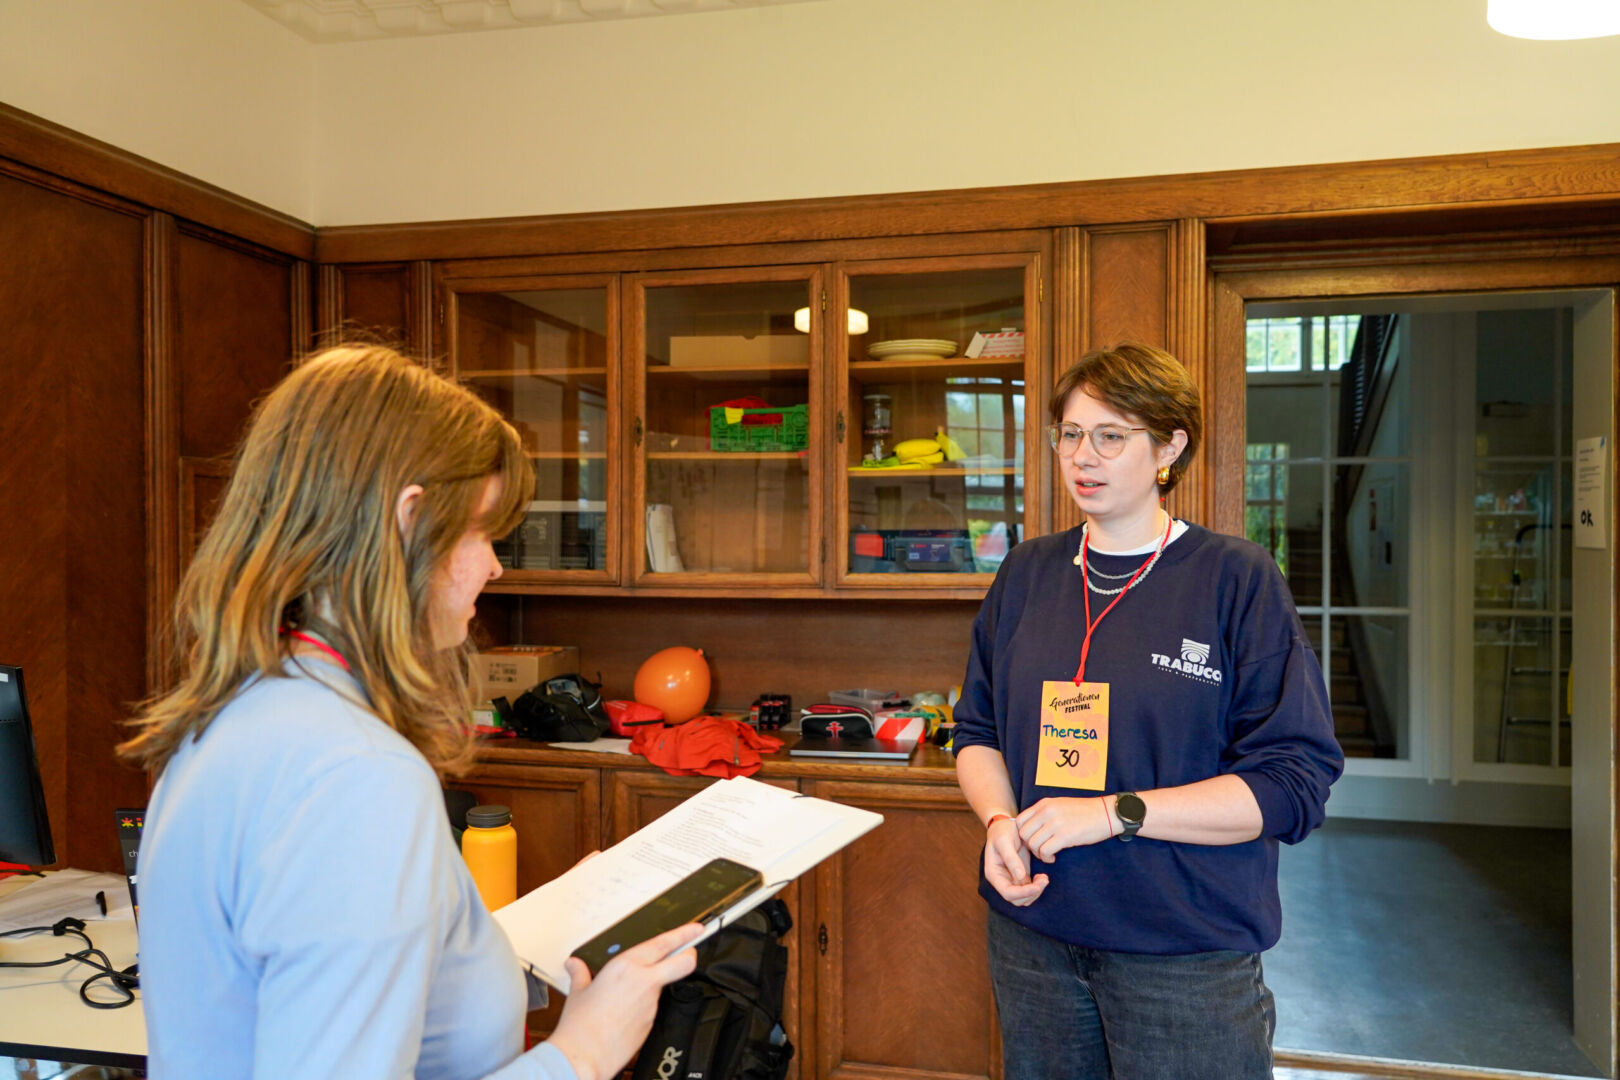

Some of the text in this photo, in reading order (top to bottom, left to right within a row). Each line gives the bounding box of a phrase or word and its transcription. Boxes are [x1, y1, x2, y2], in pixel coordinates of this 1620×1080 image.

[1151, 653, 1222, 683] TRABUCC
[1065, 703, 1091, 713] FESTIVAL
[1043, 724, 1098, 740] Theresa
[1055, 749, 1080, 767] 30
